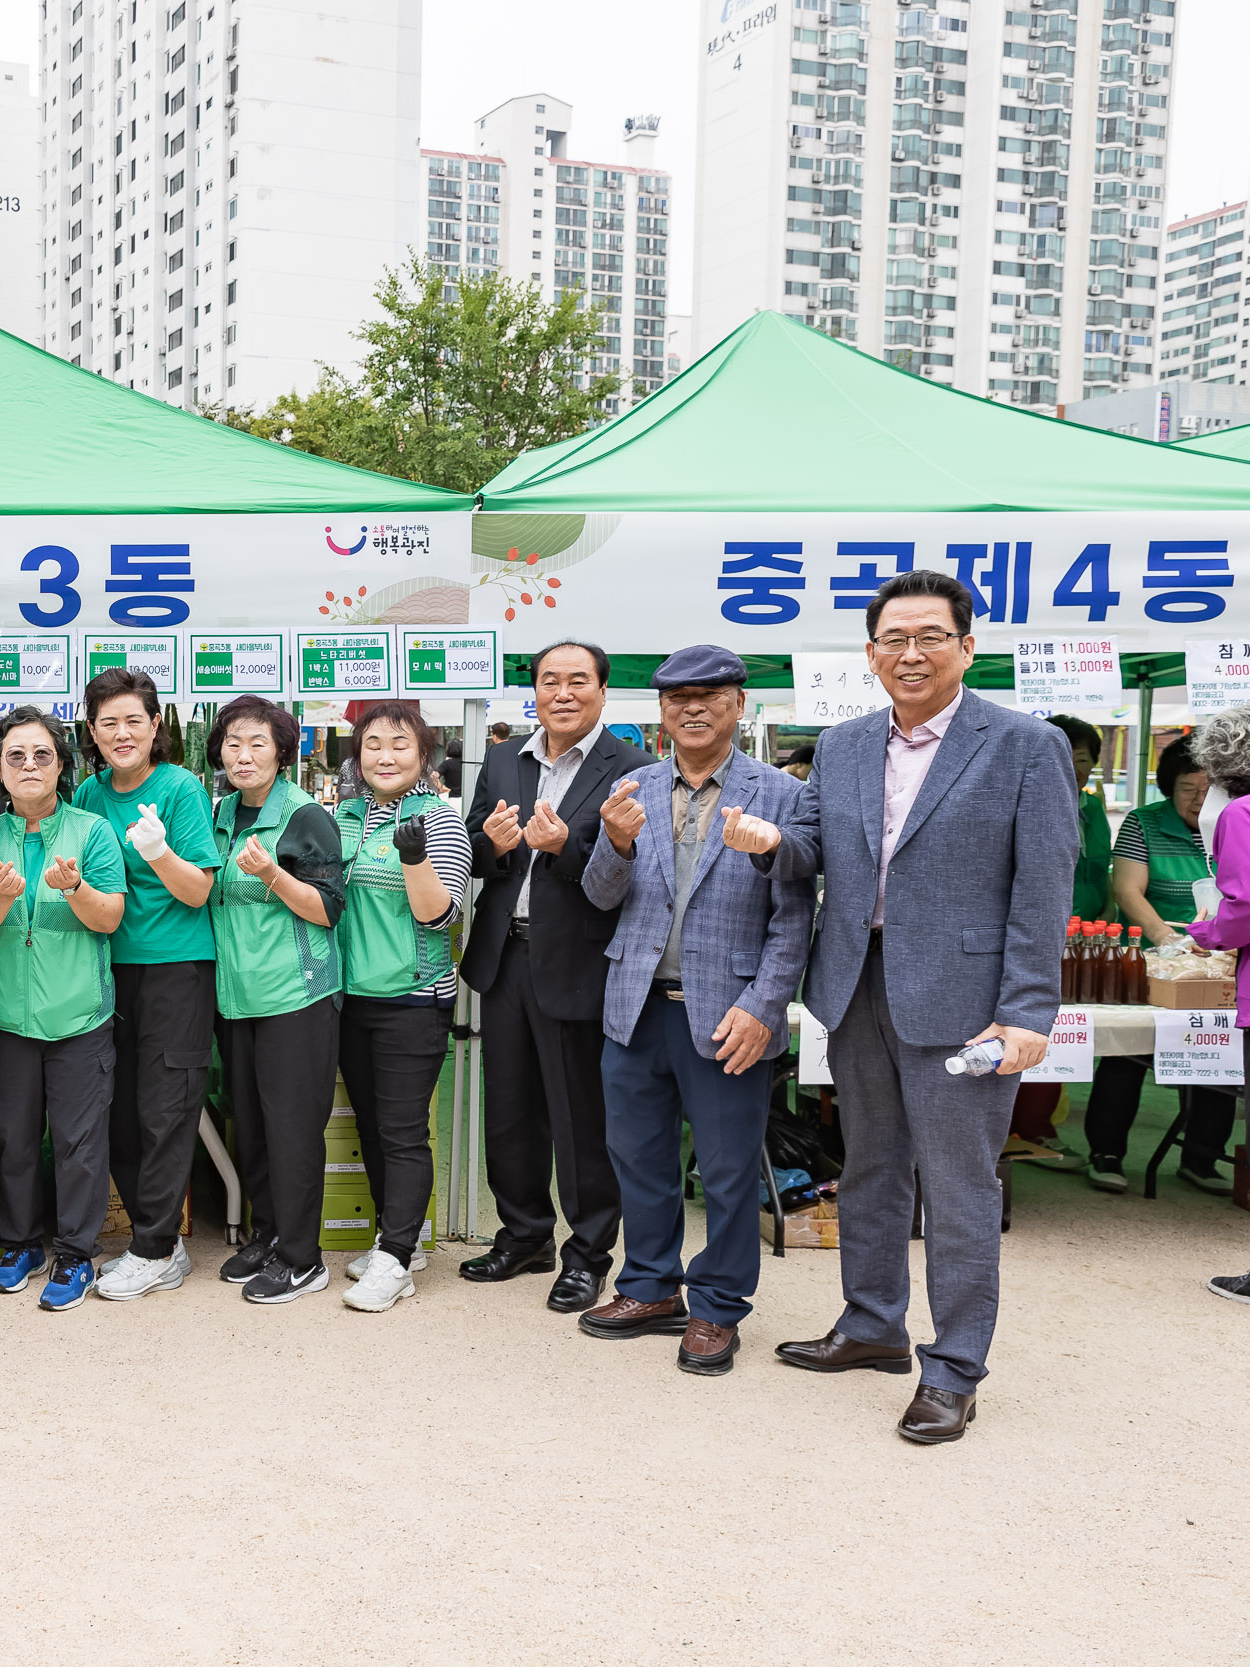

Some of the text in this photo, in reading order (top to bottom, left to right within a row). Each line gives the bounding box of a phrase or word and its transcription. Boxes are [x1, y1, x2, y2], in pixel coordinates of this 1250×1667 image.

[733, 54, 742, 70] 4
[372, 535, 430, 556] 행복광진
[717, 540, 1235, 625] 중곡제4동
[1018, 642, 1112, 656] 참기름 11,000원
[234, 663, 276, 676] 12,000원
[339, 661, 381, 673] 11,000원
[447, 660, 490, 673] 13,000원
[1019, 660, 1113, 674] 들기름 13,000원
[344, 675, 381, 687] 6,000원
[1184, 1033, 1230, 1046] 4,000원
